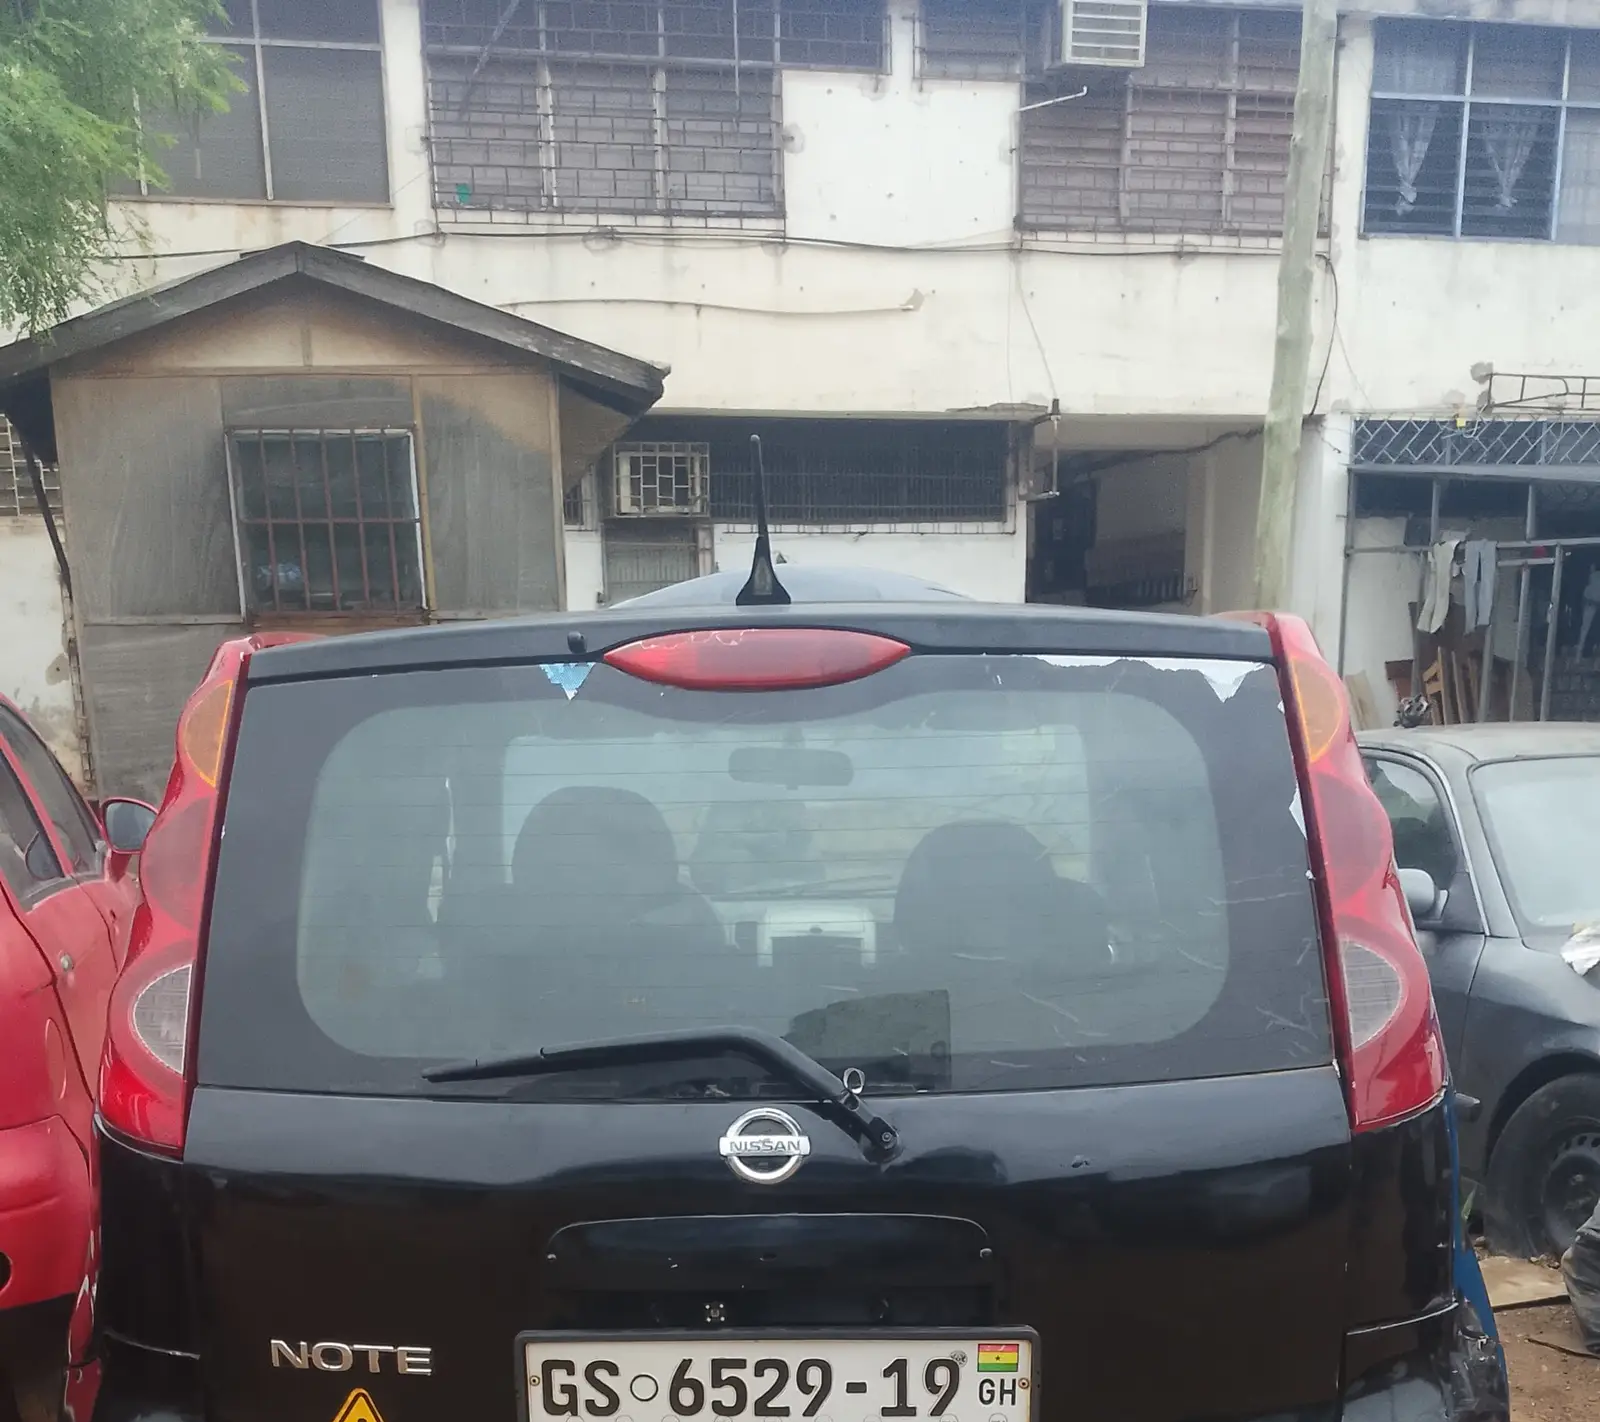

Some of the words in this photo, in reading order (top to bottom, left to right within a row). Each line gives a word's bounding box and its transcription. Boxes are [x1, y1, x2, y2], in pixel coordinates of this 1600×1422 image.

[729, 1139, 801, 1152] NISSAN
[270, 1339, 432, 1375] NOTE
[541, 1359, 620, 1417] GS
[668, 1358, 961, 1417] 6529-19
[978, 1378, 1017, 1406] GH
